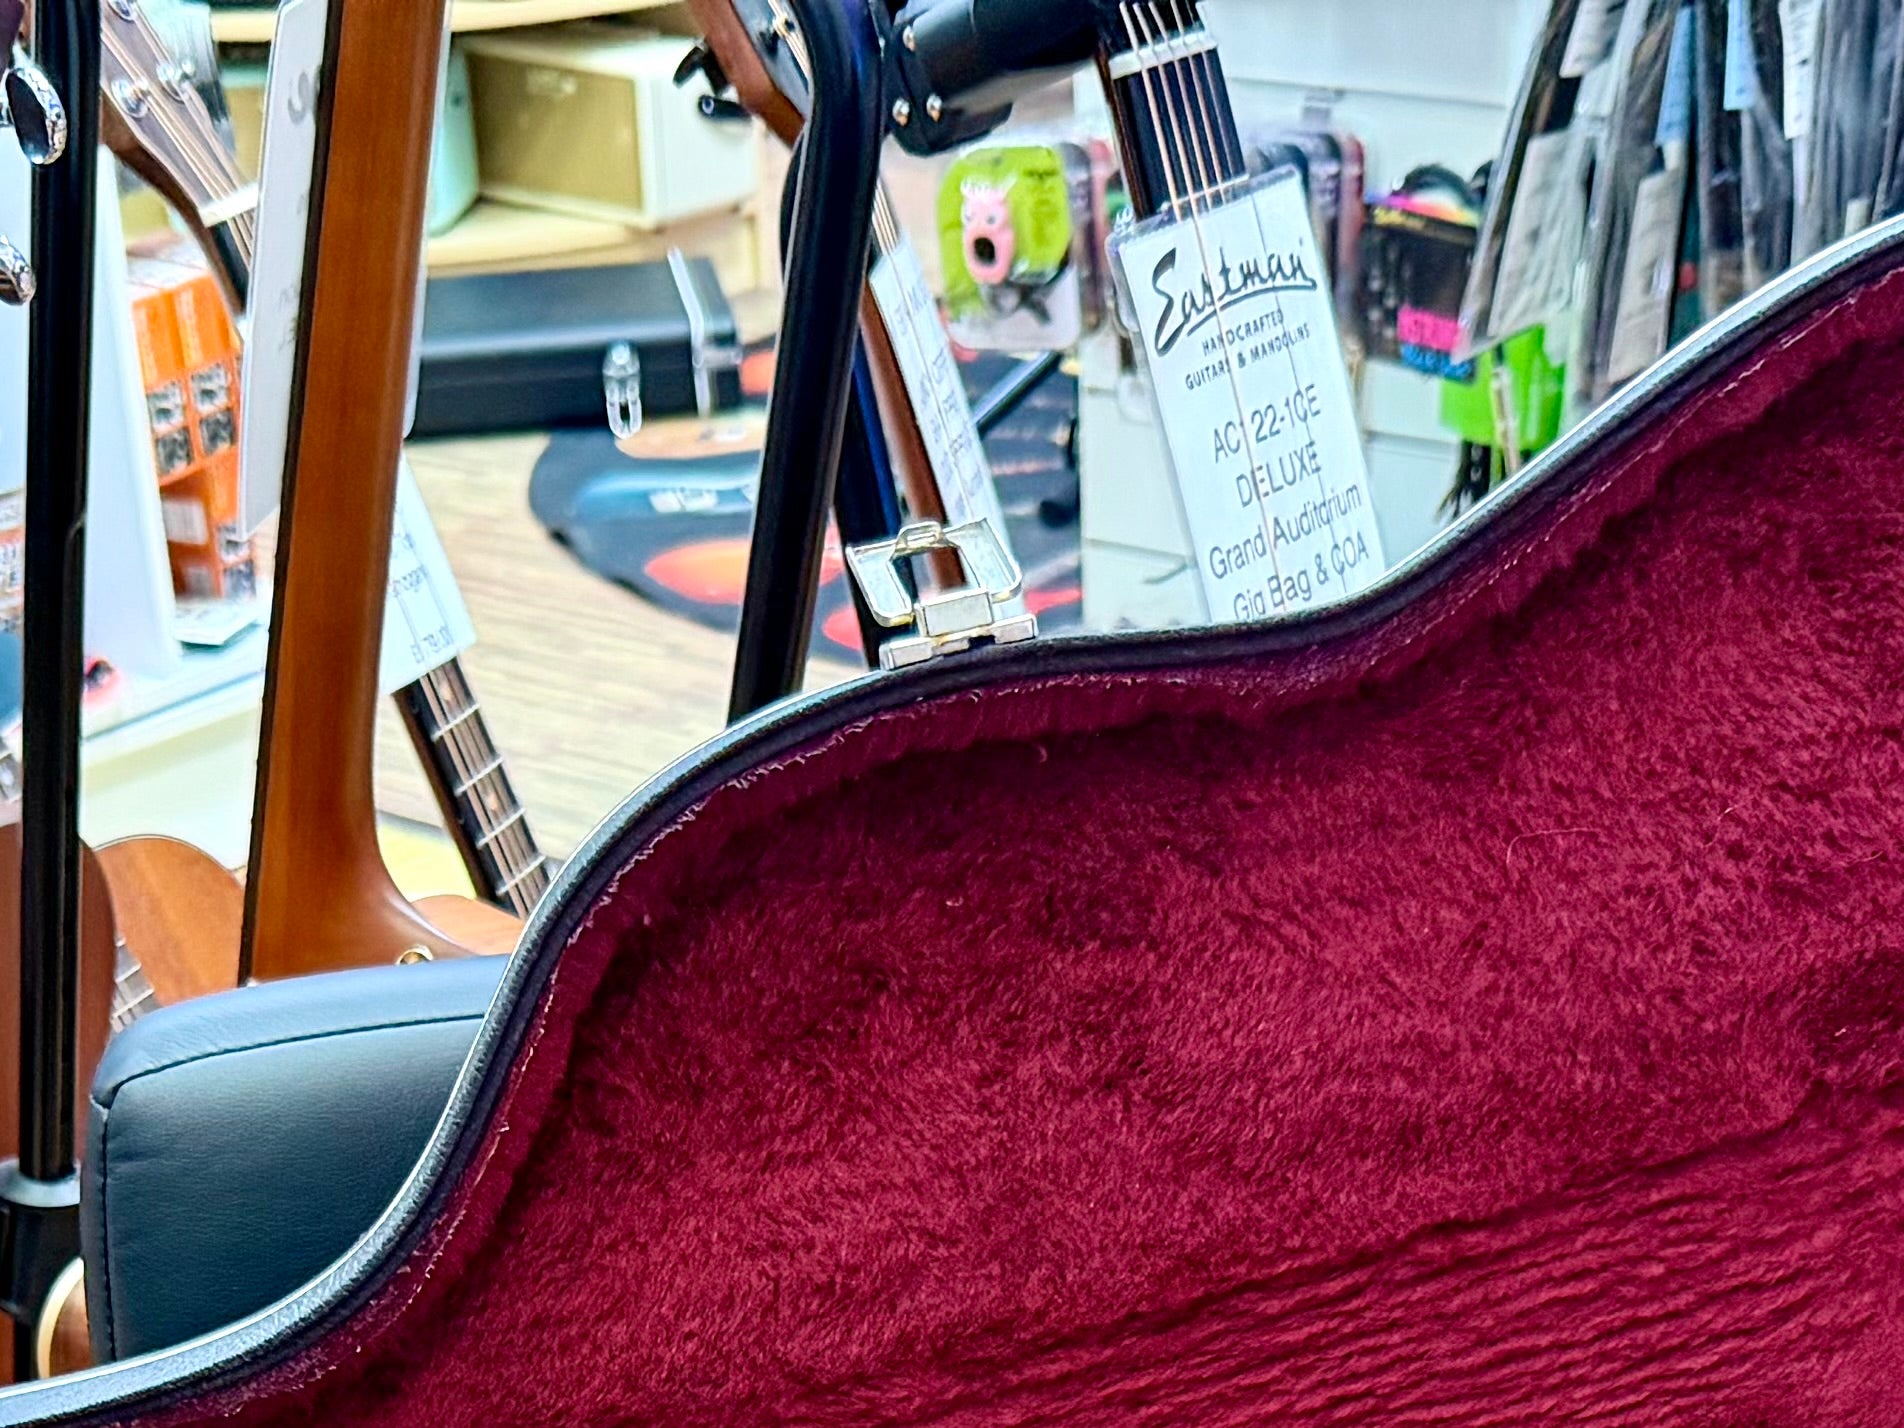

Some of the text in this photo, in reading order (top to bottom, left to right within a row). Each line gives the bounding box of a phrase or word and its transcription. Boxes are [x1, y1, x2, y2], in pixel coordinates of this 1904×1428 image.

[1152, 246, 1317, 358] Eastman
[1201, 308, 1285, 358] HANDCRAFTED
[1237, 352, 1246, 369] &
[1249, 322, 1311, 362] MANDOLINS
[1235, 440, 1322, 508] DELUXE
[1209, 484, 1362, 580] Grand Auditorium
[1267, 569, 1313, 608] Bag
[1314, 552, 1330, 586] &
[1330, 531, 1370, 577] COA
